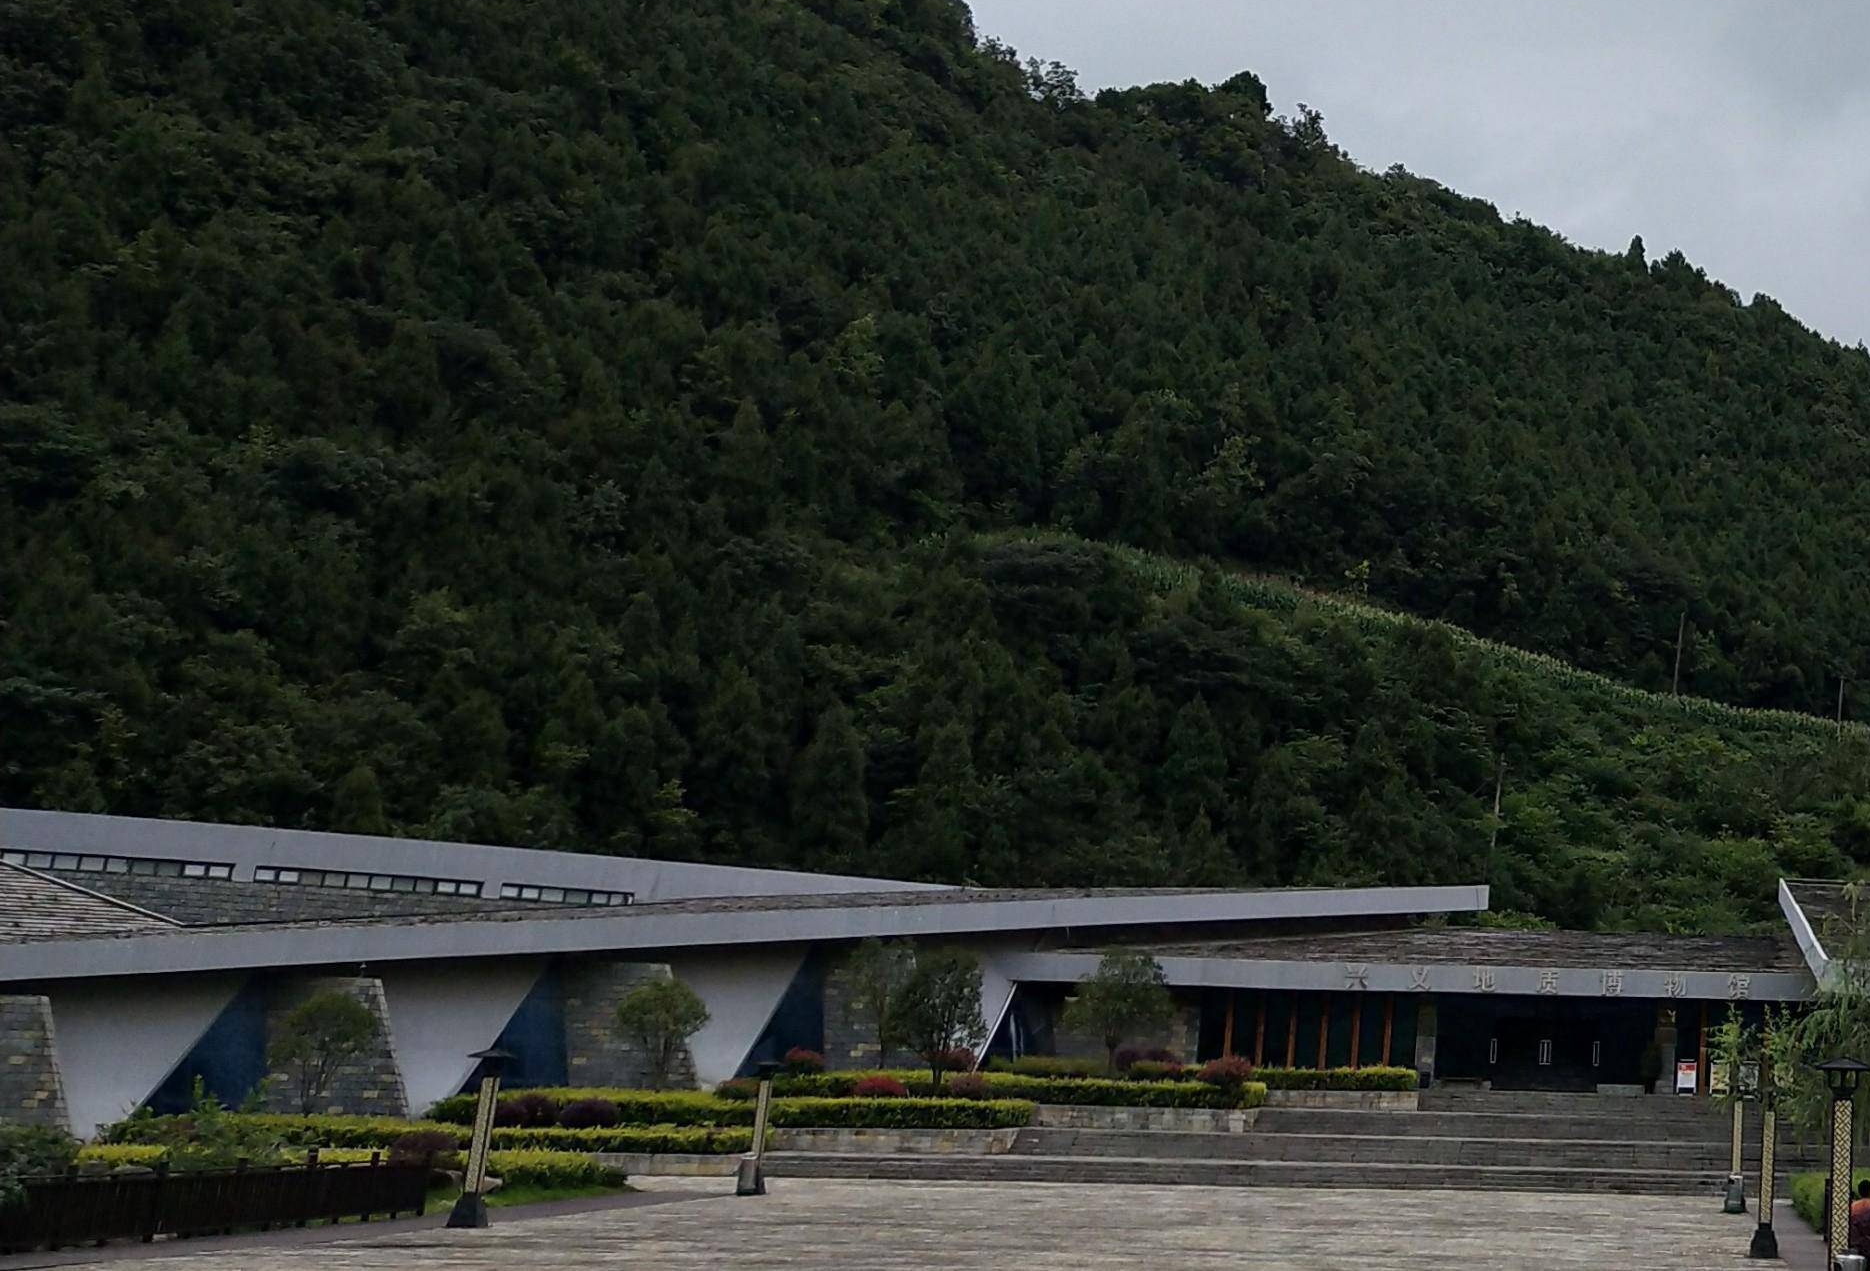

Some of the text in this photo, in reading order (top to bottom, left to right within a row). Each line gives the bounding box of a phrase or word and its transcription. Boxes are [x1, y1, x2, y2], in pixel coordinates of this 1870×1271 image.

[1344, 962, 1750, 1000] 兴义地质博物馆
